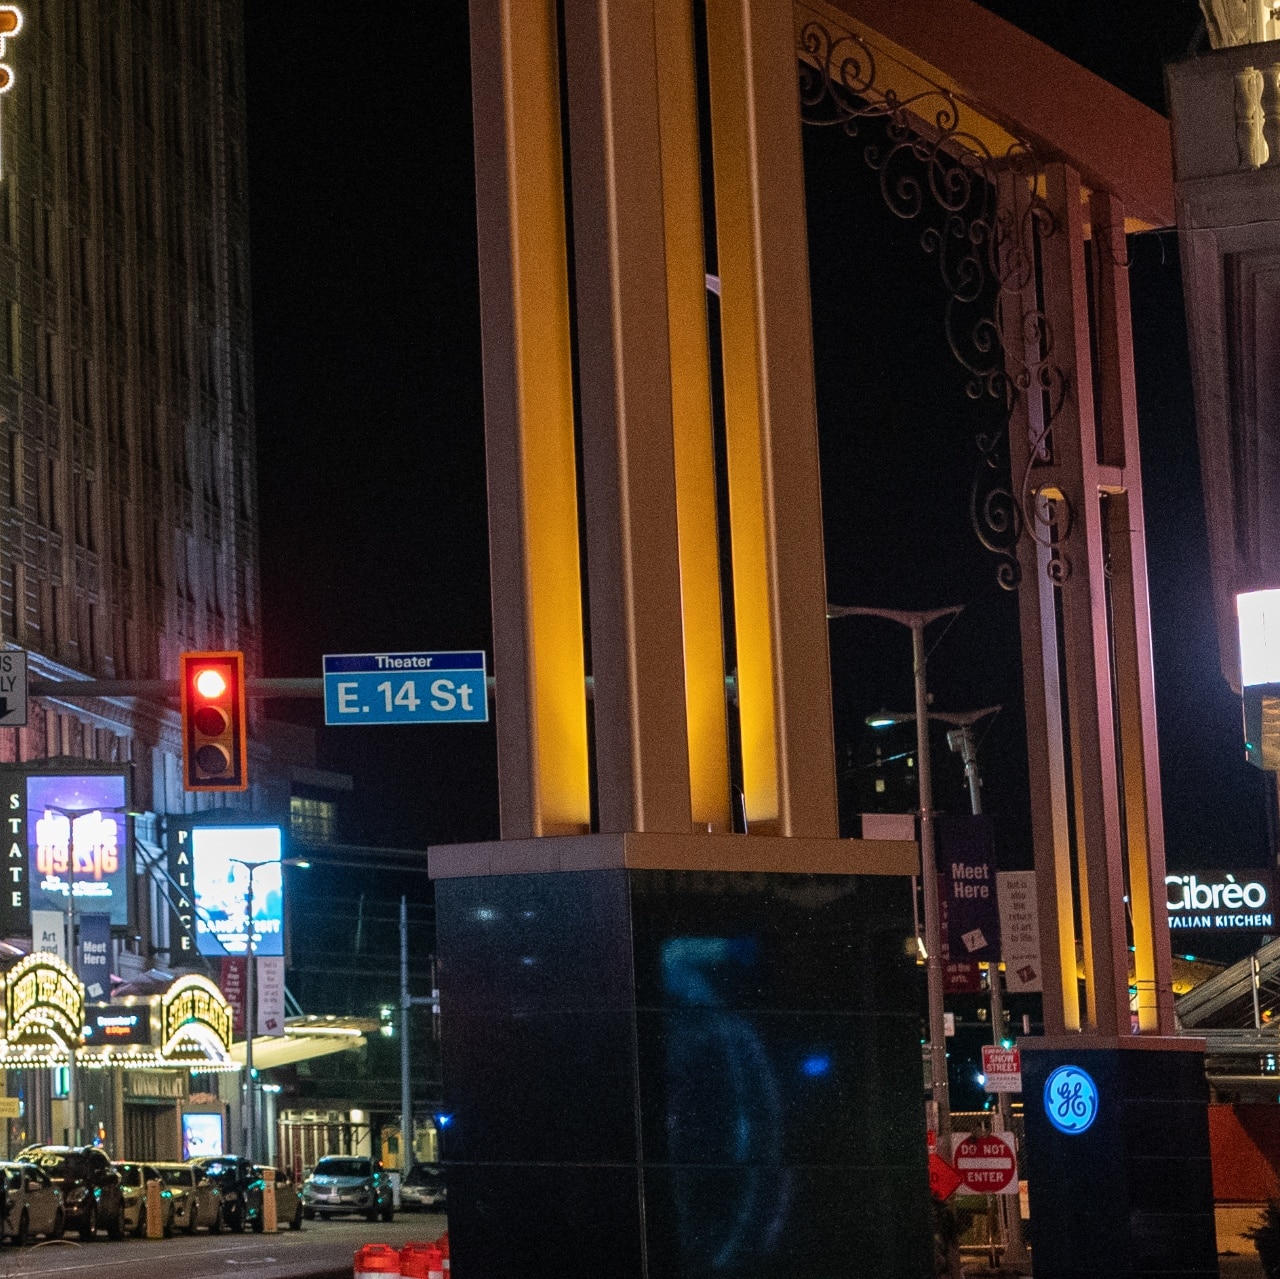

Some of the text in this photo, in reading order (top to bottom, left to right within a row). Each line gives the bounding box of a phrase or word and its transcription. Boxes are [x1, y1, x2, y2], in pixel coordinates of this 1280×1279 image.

[375, 656, 433, 668] Theater
[337, 679, 474, 713] E. 14 St
[8, 793, 22, 907] STATE
[951, 863, 989, 880] Meet
[177, 830, 192, 950] PALACE
[953, 881, 990, 898] Here
[1165, 874, 1266, 910] Cibrèo
[1168, 914, 1272, 929] TALIAN KITCHEN
[43, 930, 56, 942] Art
[83, 941, 106, 953] Meet
[84, 953, 106, 965] Here
[990, 1054, 1015, 1063] SNOW
[987, 1062, 1018, 1072] STREET
[1057, 1082, 1086, 1117] GE
[961, 1144, 1005, 1155] DO NOT
[967, 1171, 1004, 1182] ENTER
